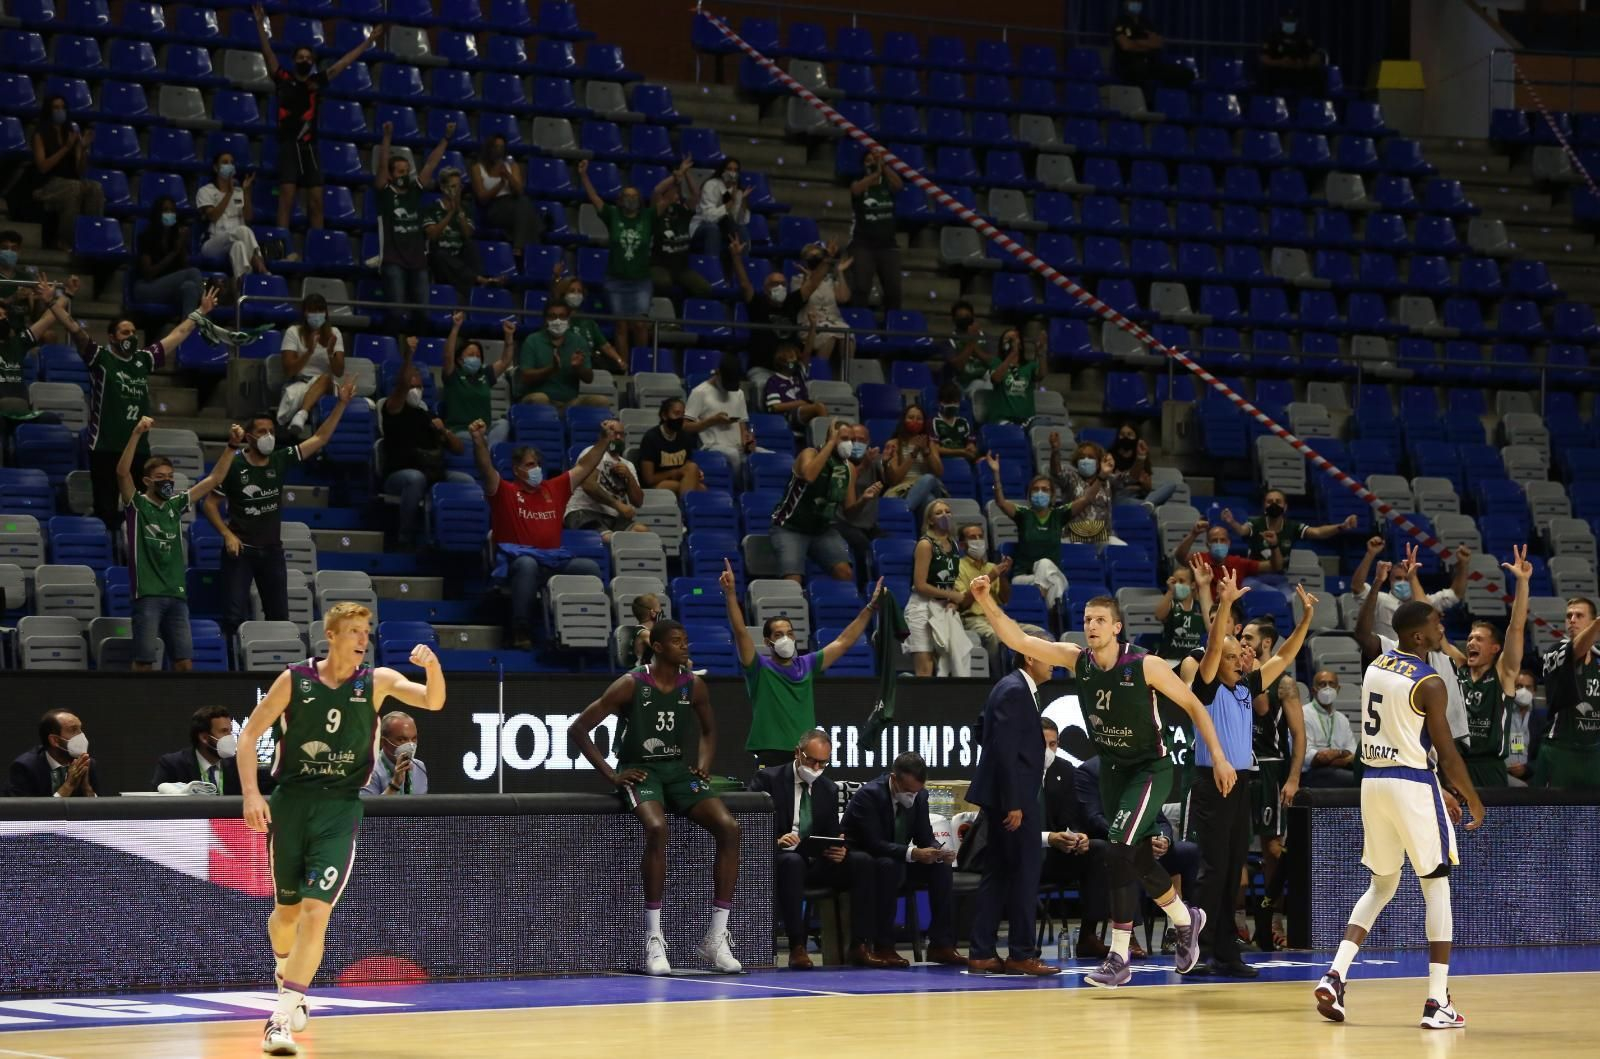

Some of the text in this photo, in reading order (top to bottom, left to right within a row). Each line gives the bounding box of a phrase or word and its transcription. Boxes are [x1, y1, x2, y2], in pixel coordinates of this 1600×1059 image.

[126, 404, 140, 421] 22
[518, 507, 557, 520] HACKETT
[1585, 678, 1600, 697] 52
[1095, 688, 1113, 711] 21
[325, 708, 342, 734] 9
[655, 711, 675, 731] 33
[1364, 692, 1384, 736] 5
[1102, 726, 1133, 737] Unicaja
[1361, 744, 1399, 762] LOGNE
[1263, 806, 1273, 826] 0
[319, 866, 339, 891] 9
